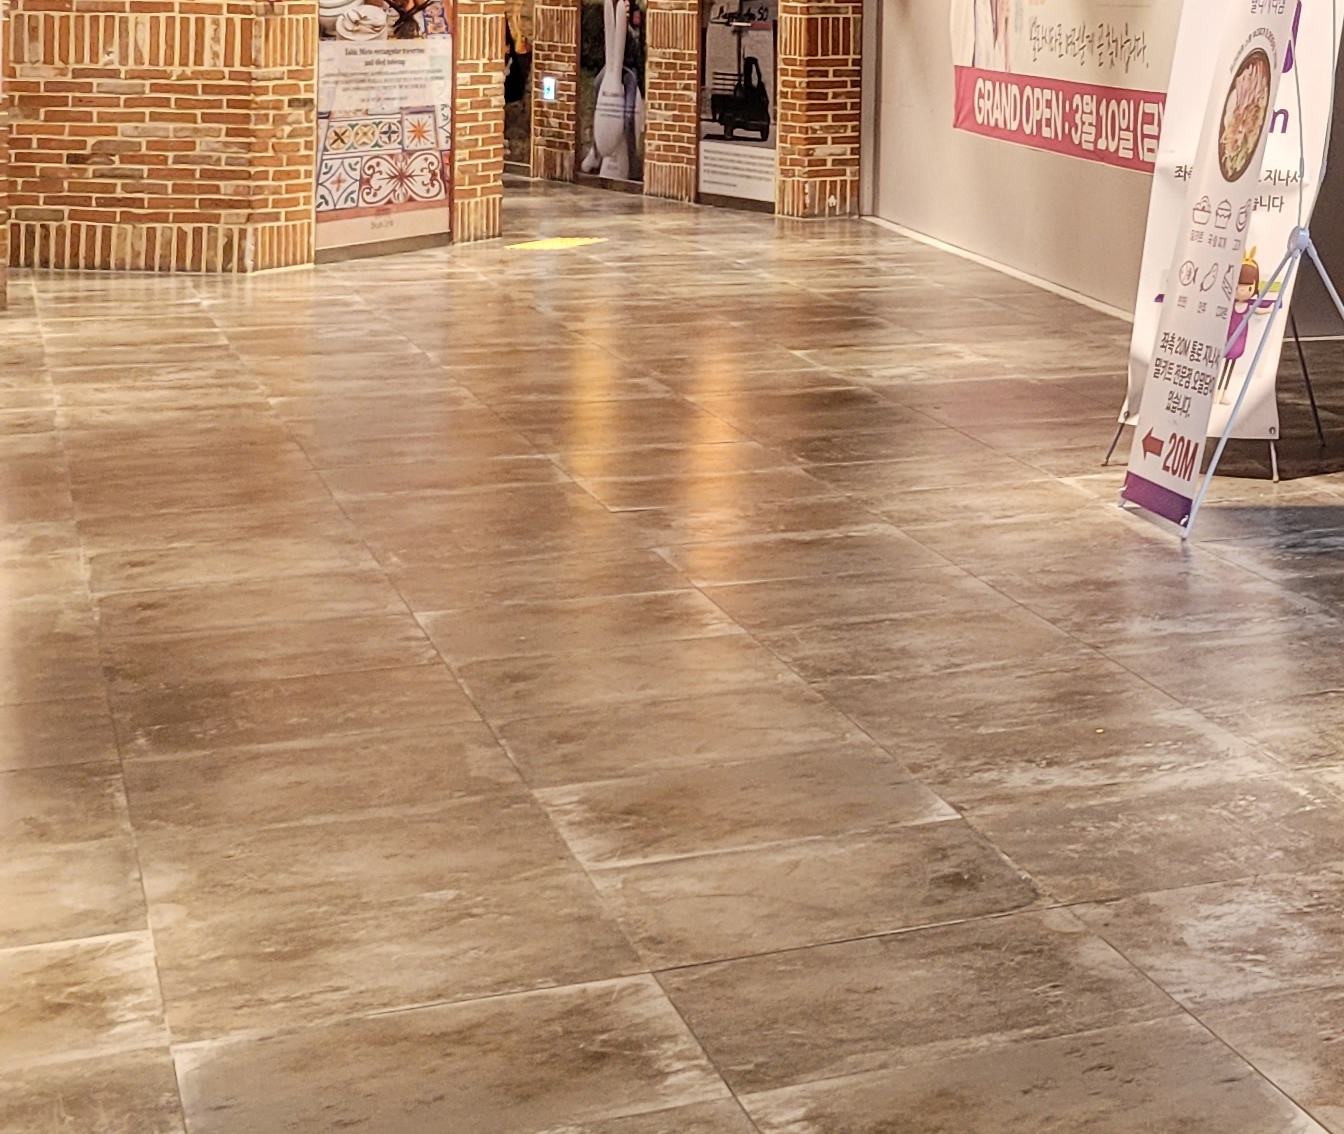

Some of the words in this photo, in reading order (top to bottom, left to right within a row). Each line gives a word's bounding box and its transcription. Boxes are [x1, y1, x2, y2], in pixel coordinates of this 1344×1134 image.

[974, 78, 1021, 131] GRAND
[1022, 85, 1063, 141] OPEN
[1071, 94, 1096, 151] 3월
[1097, 97, 1134, 159] 10일
[1162, 432, 1199, 482] 20M
